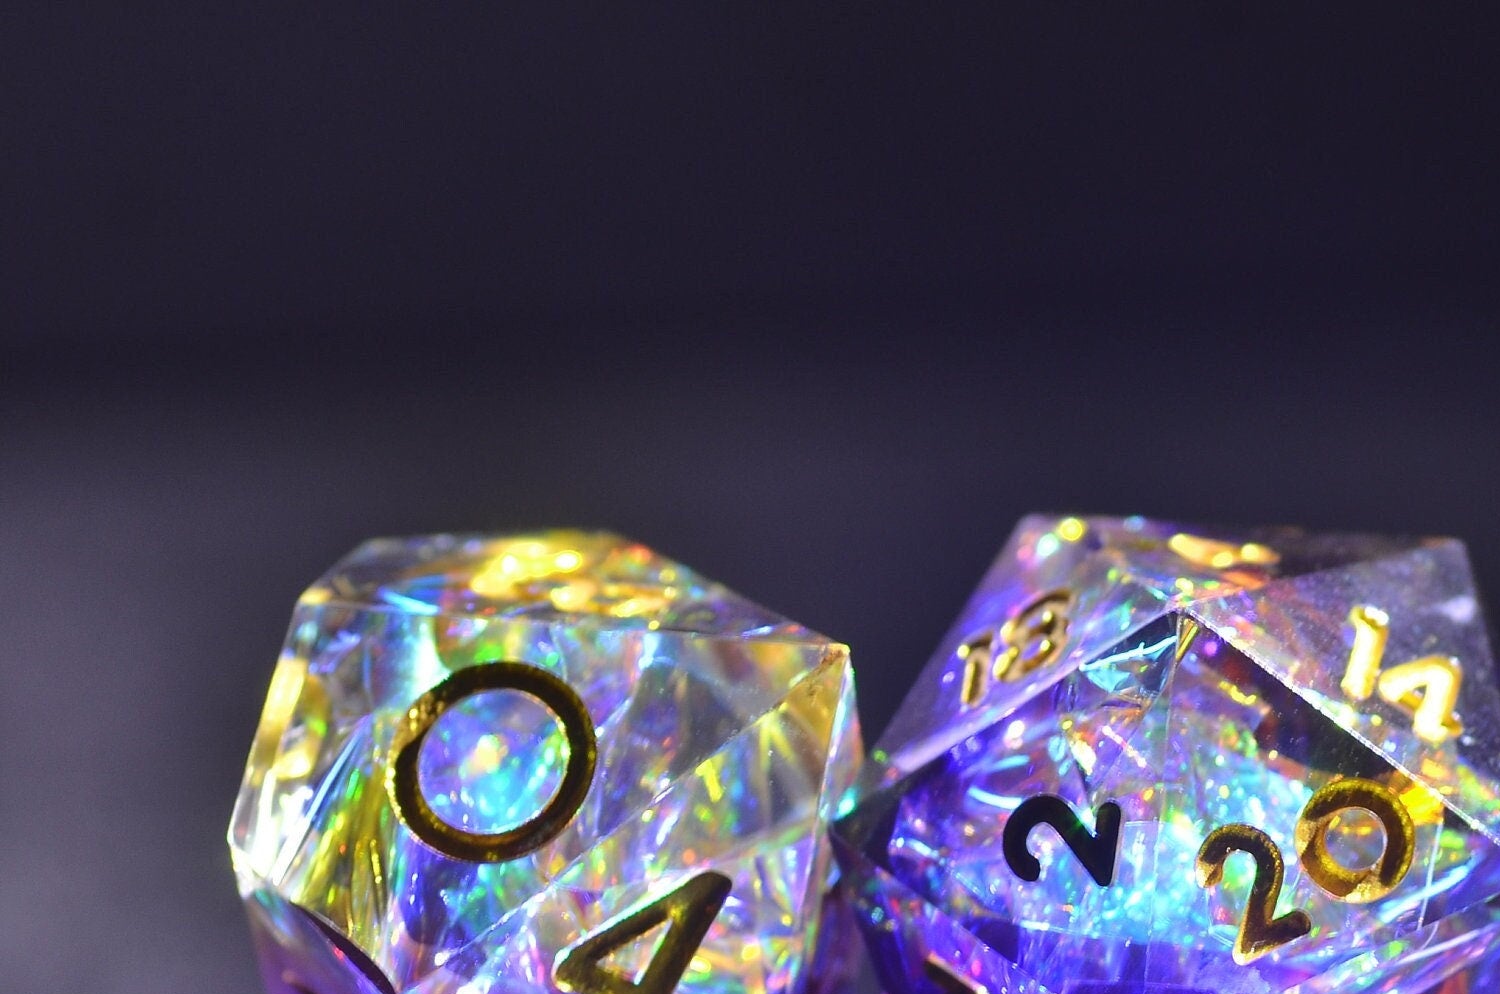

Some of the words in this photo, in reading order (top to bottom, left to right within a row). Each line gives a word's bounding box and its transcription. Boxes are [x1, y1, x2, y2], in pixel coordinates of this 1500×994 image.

[957, 583, 1073, 707] 18
[386, 660, 598, 865] 0
[1002, 795, 1123, 887] 2
[1195, 777, 1416, 966] 20
